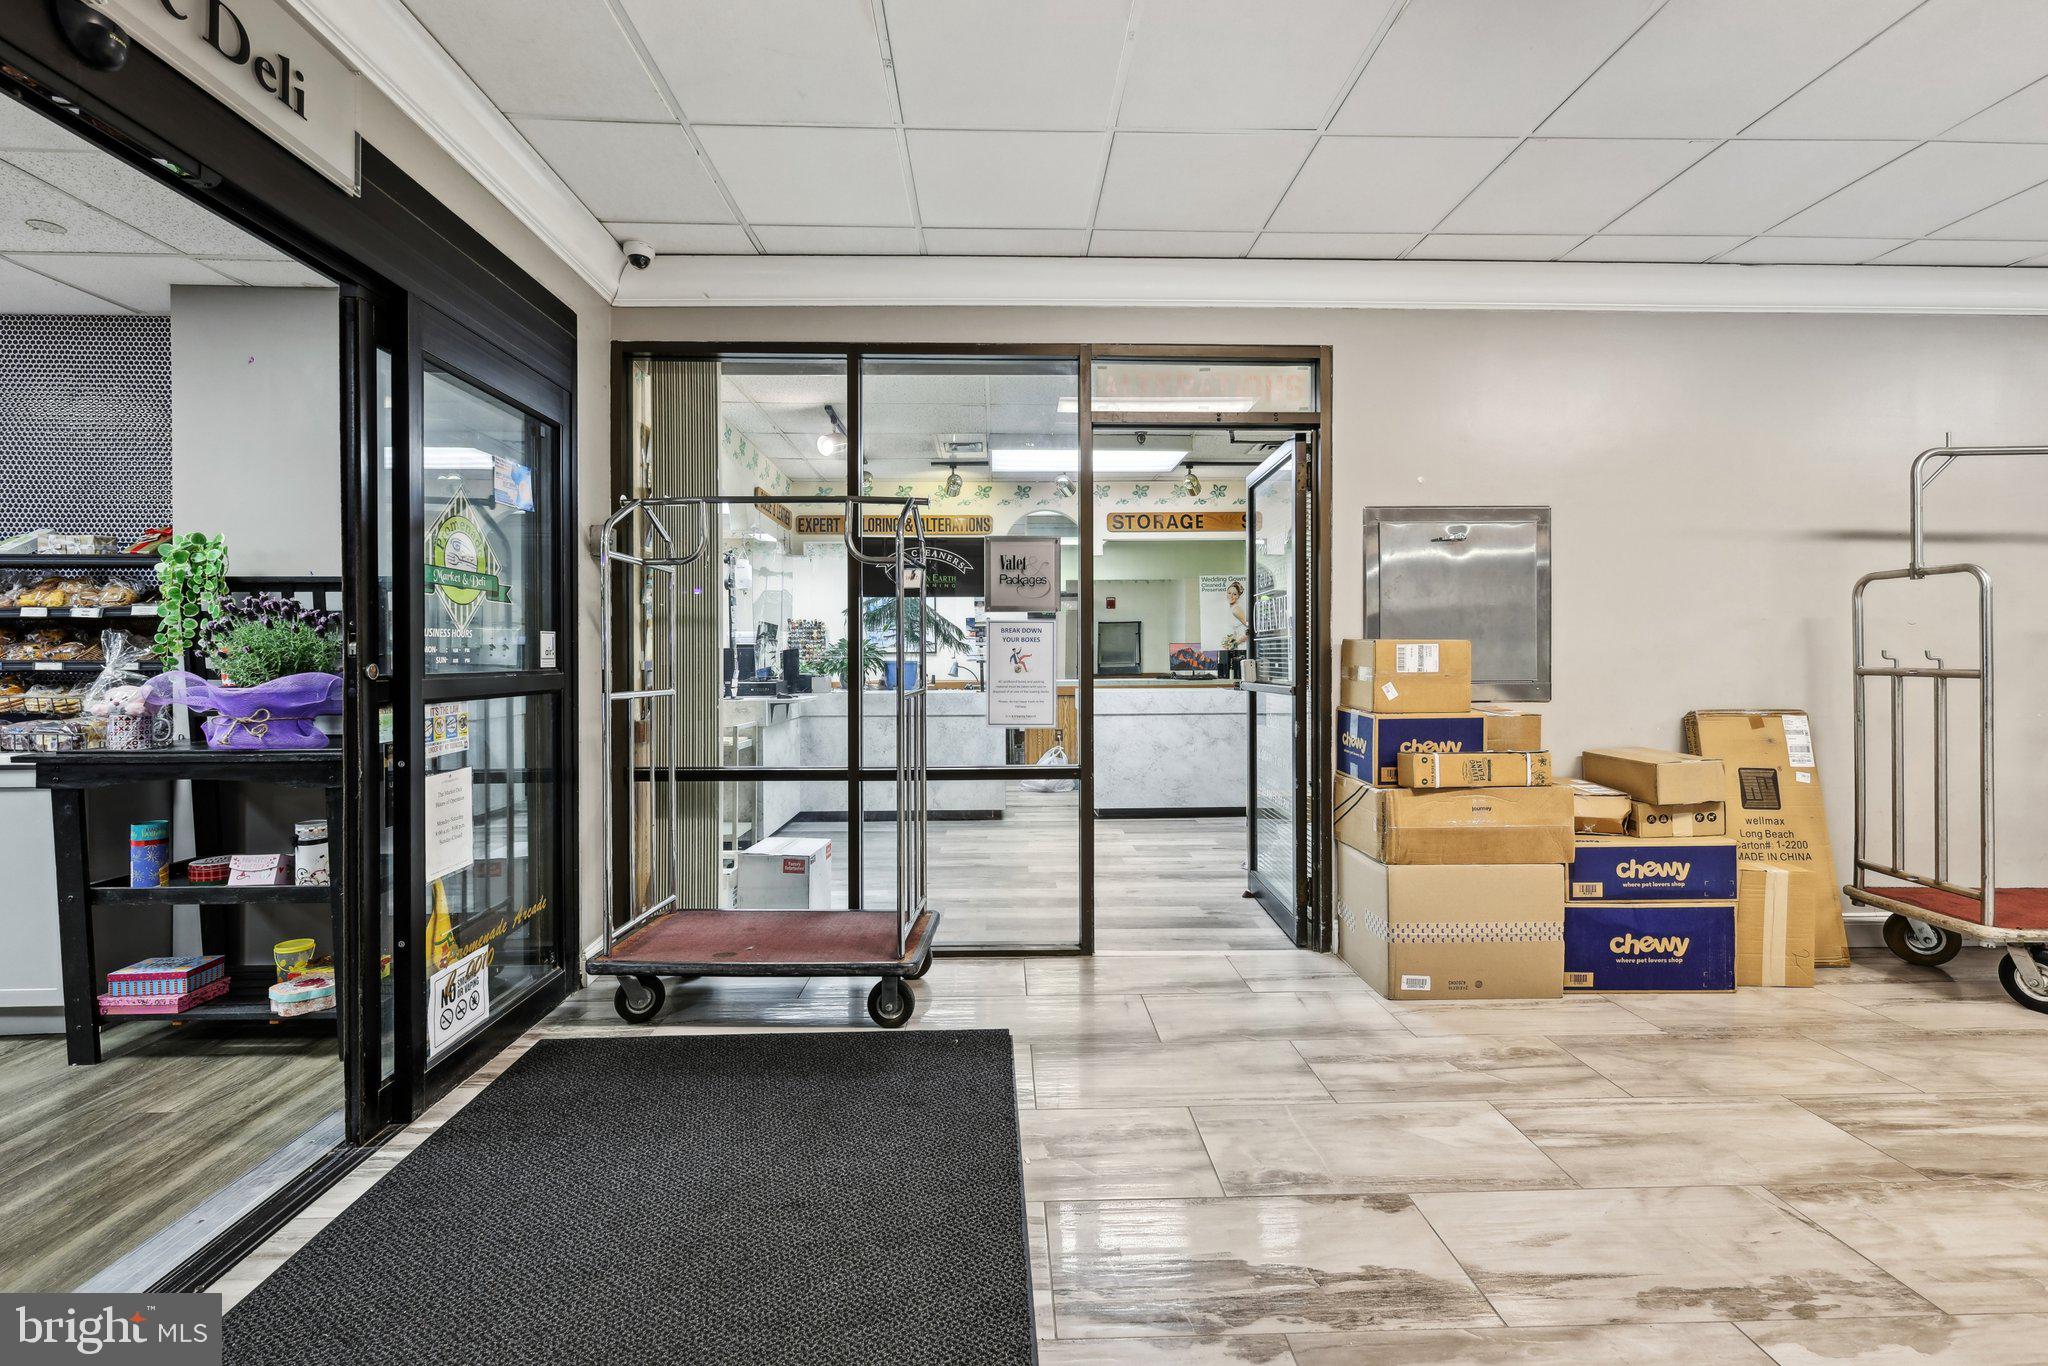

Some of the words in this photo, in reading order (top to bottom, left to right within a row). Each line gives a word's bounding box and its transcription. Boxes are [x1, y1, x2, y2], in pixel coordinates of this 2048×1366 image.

[202, 0, 307, 121] Deli
[798, 517, 840, 533] EXPERT
[905, 519, 913, 532] &
[1112, 514, 1204, 529] STORAGE
[911, 549, 966, 571] CEANERS
[1000, 555, 1026, 572] Valet
[1000, 573, 1048, 588] Packages
[424, 627, 451, 638] USINESS
[451, 629, 473, 639] HOURS
[1342, 731, 1367, 754] chewy
[1469, 759, 1479, 782] LIVING
[1476, 760, 1486, 781] PLANT
[1745, 817, 1785, 826] wellmax
[1740, 829, 1763, 840] Long
[1765, 829, 1795, 839] Beach
[1777, 840, 1809, 850] 1-2200
[1738, 852, 1764, 861] MADE
[1768, 852, 1778, 861] IN
[1780, 852, 1813, 861] CHINA
[1616, 859, 1691, 881] chewy
[1609, 933, 1690, 957] chewy
